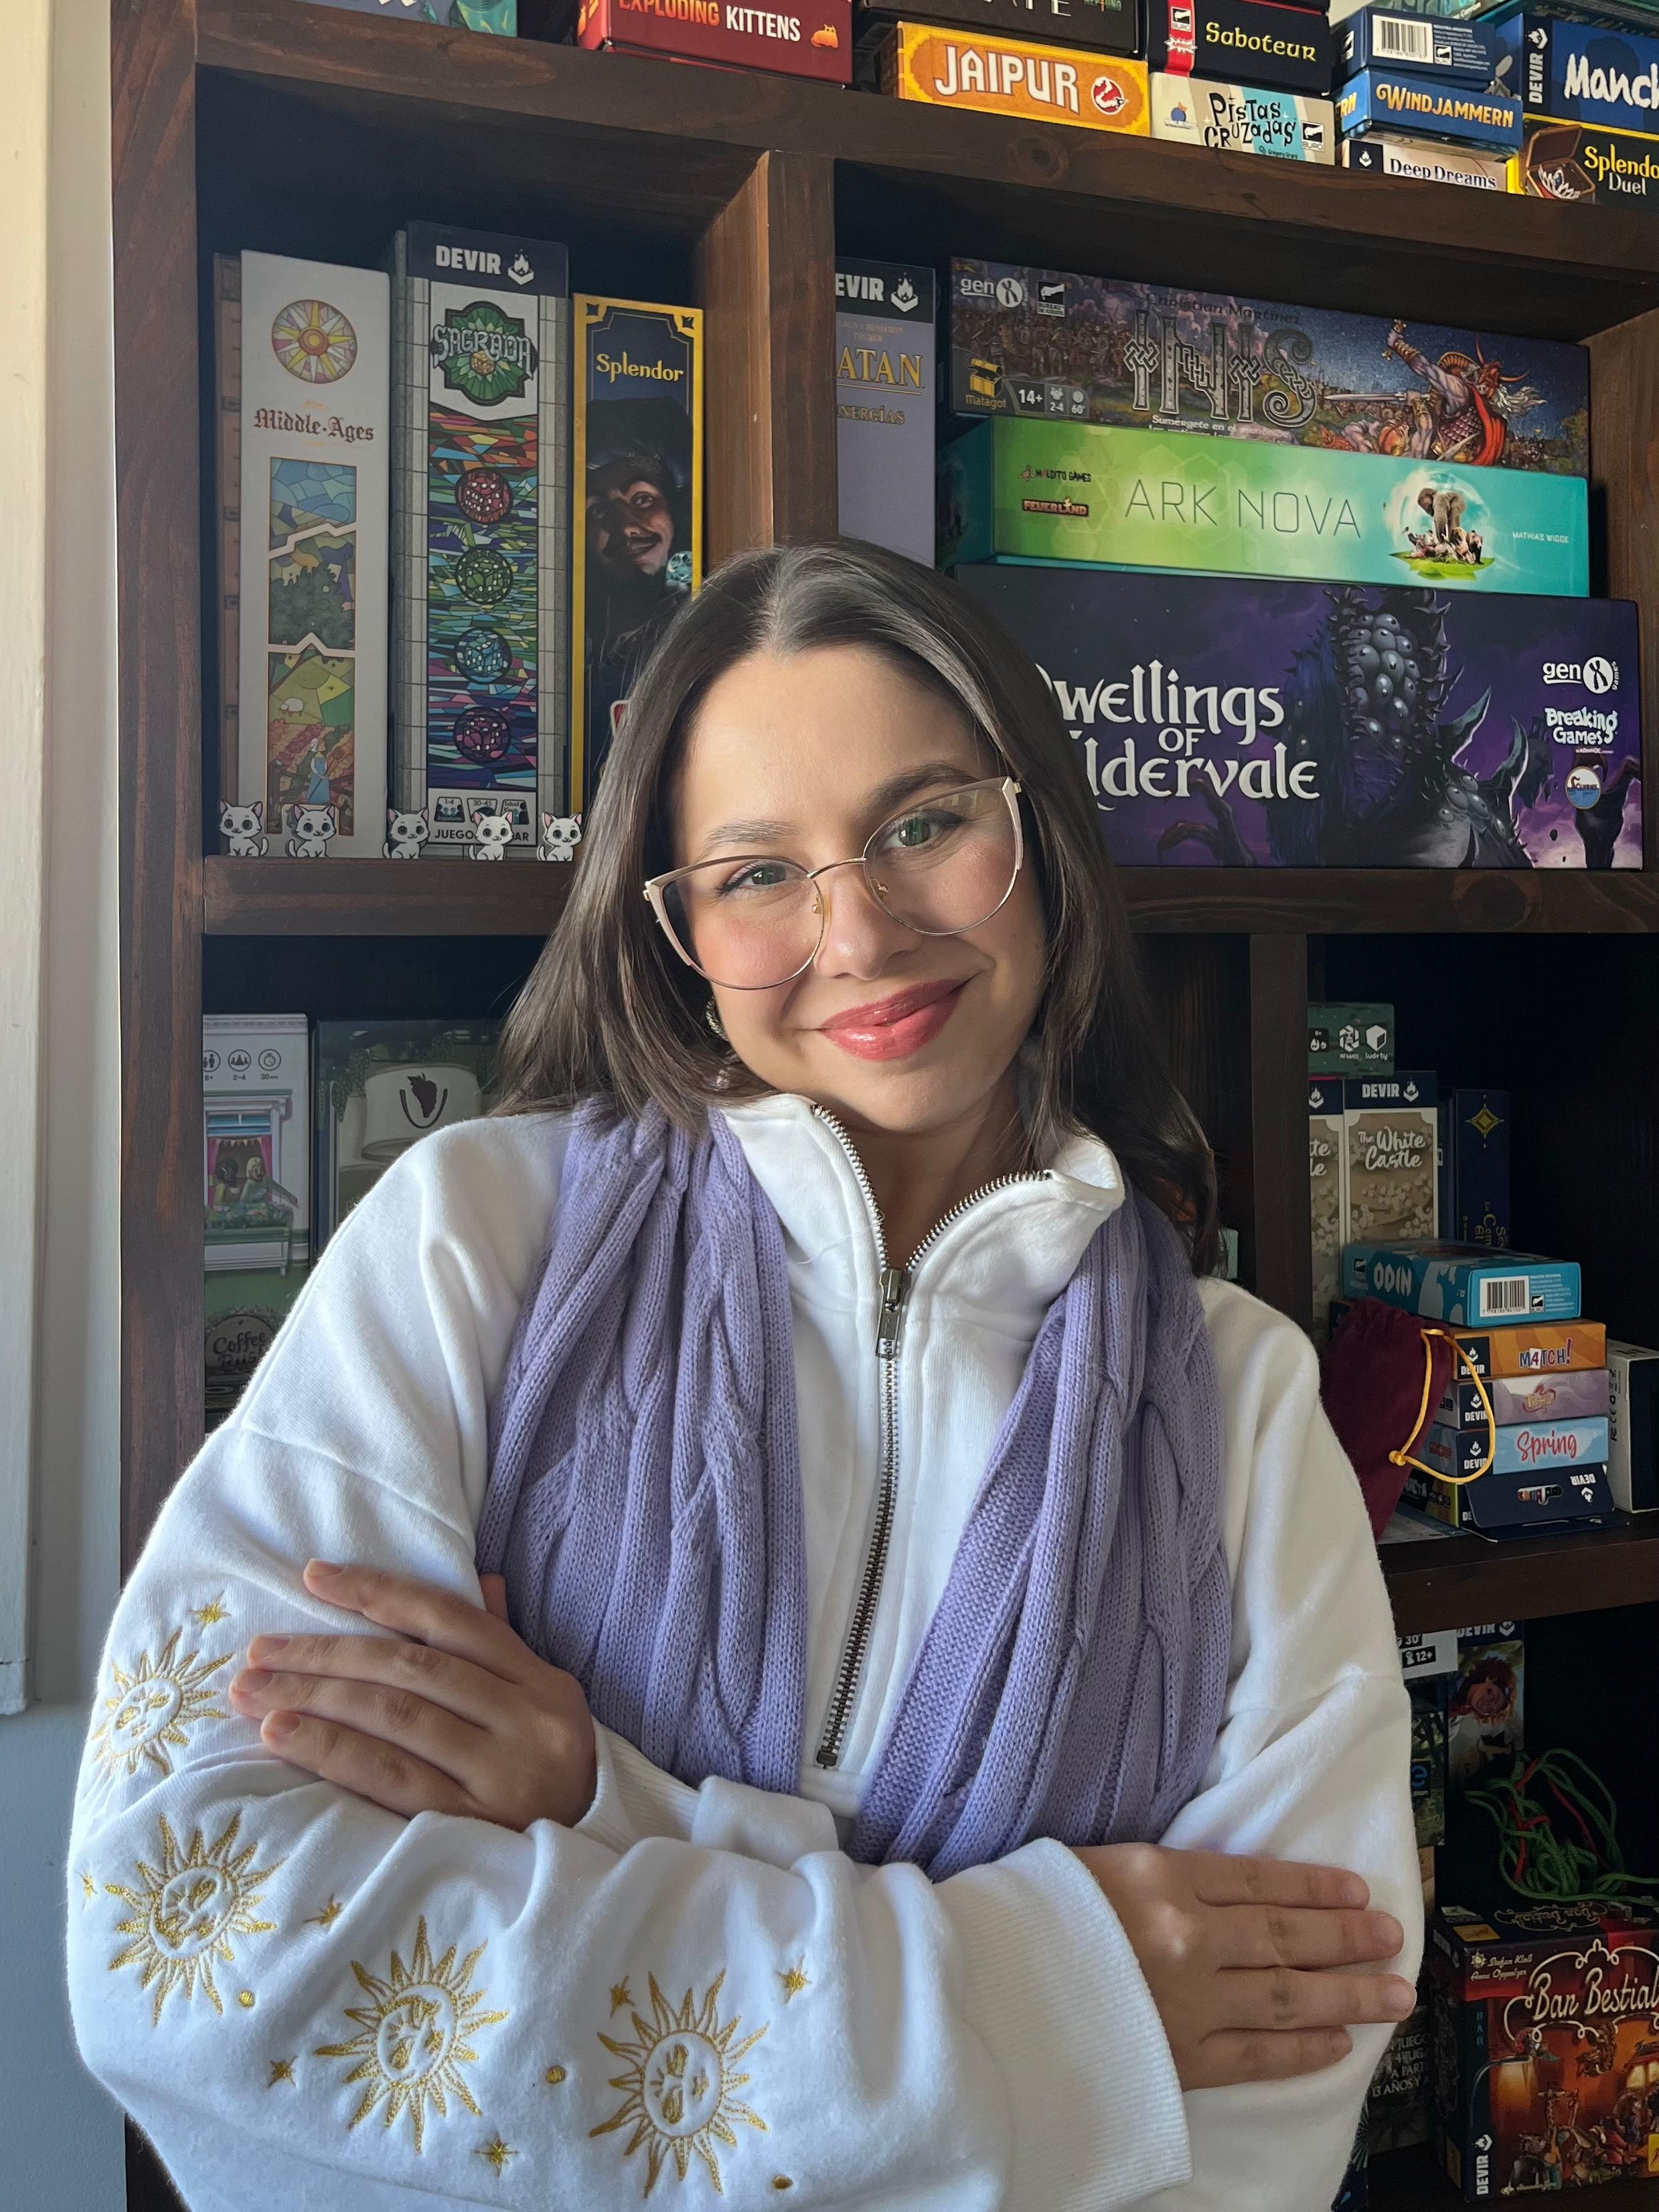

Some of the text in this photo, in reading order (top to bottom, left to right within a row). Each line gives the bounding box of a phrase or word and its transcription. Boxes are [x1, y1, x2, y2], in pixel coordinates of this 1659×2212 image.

[726, 5, 801, 42] KITTENS
[934, 44, 1080, 115] JAIPUR
[1528, 53, 1543, 104] DEVIR
[1376, 83, 1514, 129] WINDJAMMERN
[1390, 158, 1497, 189] Deep Dreams
[1609, 172, 1646, 196] Duel
[436, 245, 501, 275] DEVIR
[836, 273, 884, 301] EVIR
[596, 350, 684, 384] Splendor
[836, 345, 921, 388] ATAN
[1018, 389, 1043, 405] 14+
[1050, 402, 1064, 412] 2-4
[1125, 479, 1360, 538] ARK NOVA
[1035, 659, 1284, 744] wellings
[1545, 707, 1618, 745] Breaking
[1553, 726, 1603, 745] Games
[1158, 728, 1206, 757] OF
[1071, 730, 1320, 809] ldervale
[435, 830, 475, 840] JUEGO
[1362, 1083, 1400, 1099] DEVIR
[1358, 1125, 1426, 1152] The White
[1365, 1146, 1423, 1170] Castle
[1373, 1262, 1412, 1297] ODIN
[213, 1330, 267, 1354] Coffee
[1460, 1364, 1486, 1376] DEIR
[1516, 1429, 1577, 1464] Spring
[1569, 1473, 1597, 1486] DEVIR
[1415, 1650, 1433, 1662] 12+
[1584, 1967, 1659, 2014] Bestial
[1476, 2154, 1490, 2196] DEVIR
